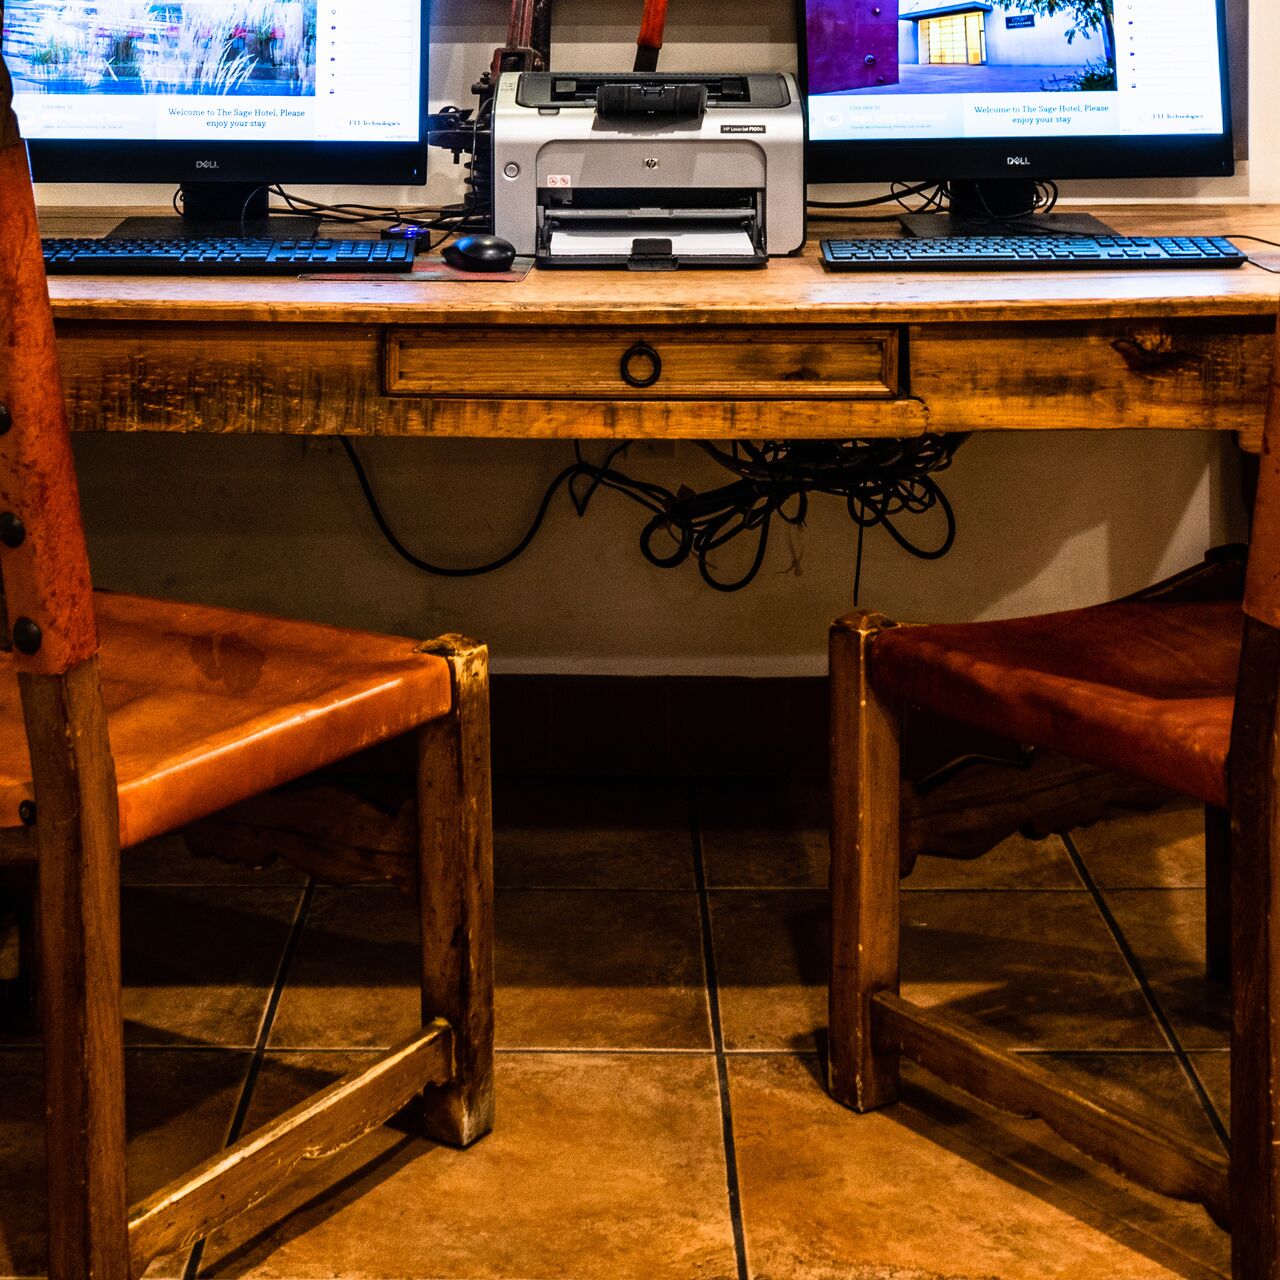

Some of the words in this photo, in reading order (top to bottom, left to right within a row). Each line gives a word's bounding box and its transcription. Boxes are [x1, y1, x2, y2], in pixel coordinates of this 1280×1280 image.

[168, 108, 205, 116] Welcome
[217, 108, 232, 116] The
[233, 109, 252, 118] Sage
[280, 109, 305, 117] Please
[1022, 105, 1036, 113] The
[1038, 105, 1057, 114] Sage
[1084, 104, 1109, 112] Please
[206, 120, 228, 128] enjoy
[1012, 117, 1033, 125] enjoy
[1035, 117, 1053, 125] your
[1055, 116, 1071, 124] stay
[195, 160, 219, 168] DELL
[1007, 156, 1030, 165] DELL
